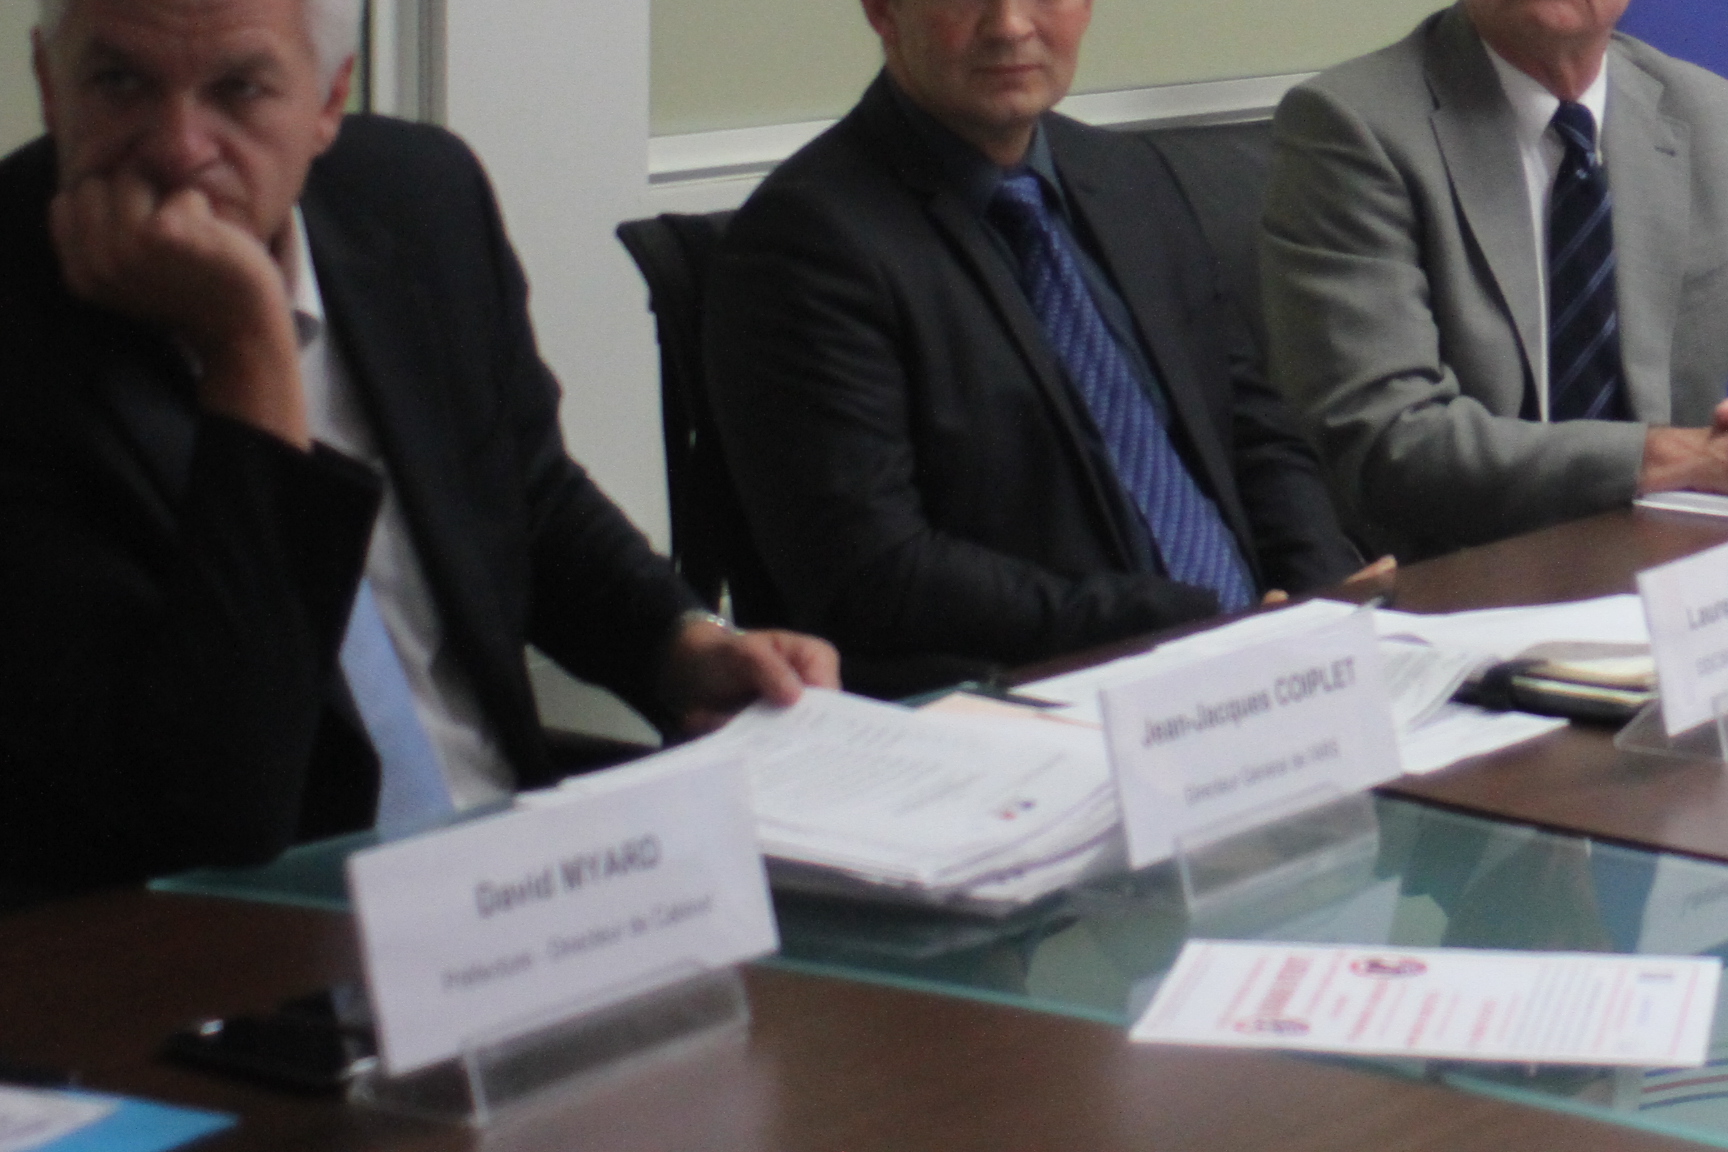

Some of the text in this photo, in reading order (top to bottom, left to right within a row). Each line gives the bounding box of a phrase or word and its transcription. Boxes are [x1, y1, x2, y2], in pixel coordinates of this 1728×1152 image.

[1143, 657, 1354, 748] Jean-Jacques COIPLET
[477, 865, 552, 917] David
